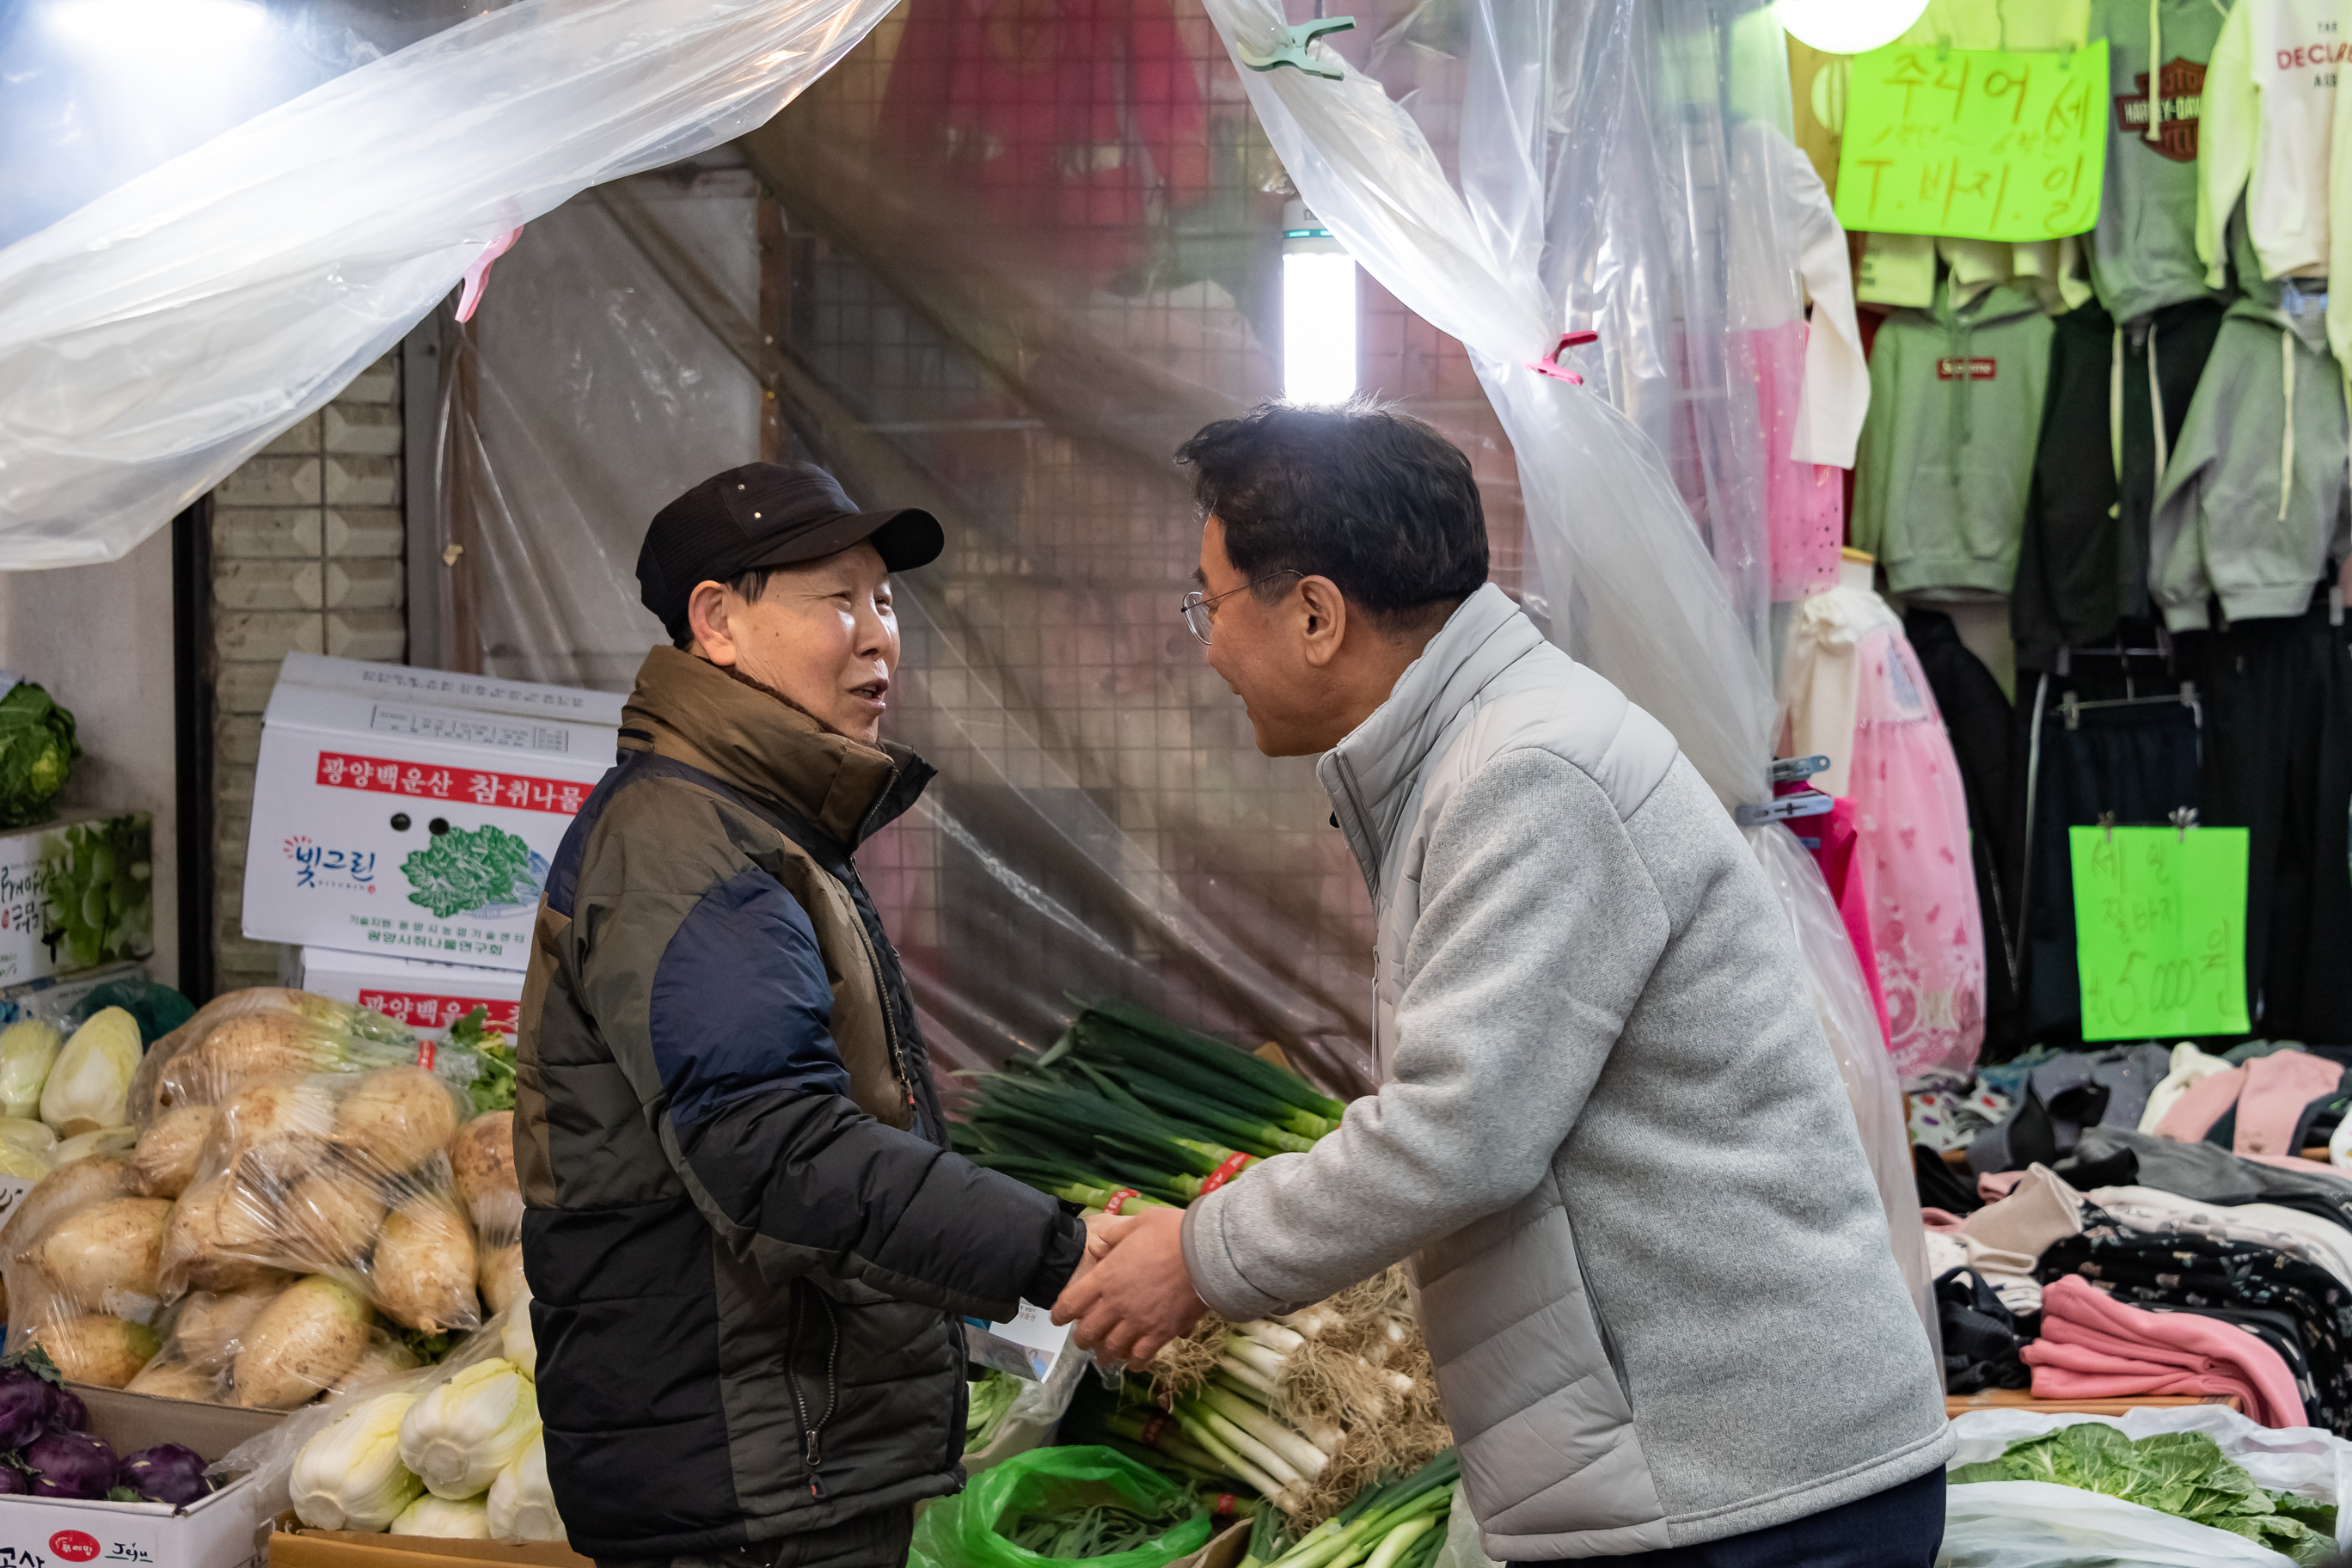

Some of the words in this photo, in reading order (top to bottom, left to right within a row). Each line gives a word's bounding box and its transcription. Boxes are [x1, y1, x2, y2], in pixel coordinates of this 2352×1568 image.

[321, 757, 454, 797] 광양백운산
[467, 774, 585, 812] 참취나물
[295, 845, 377, 888] 빛그린
[112, 1541, 148, 1563] Jeju
